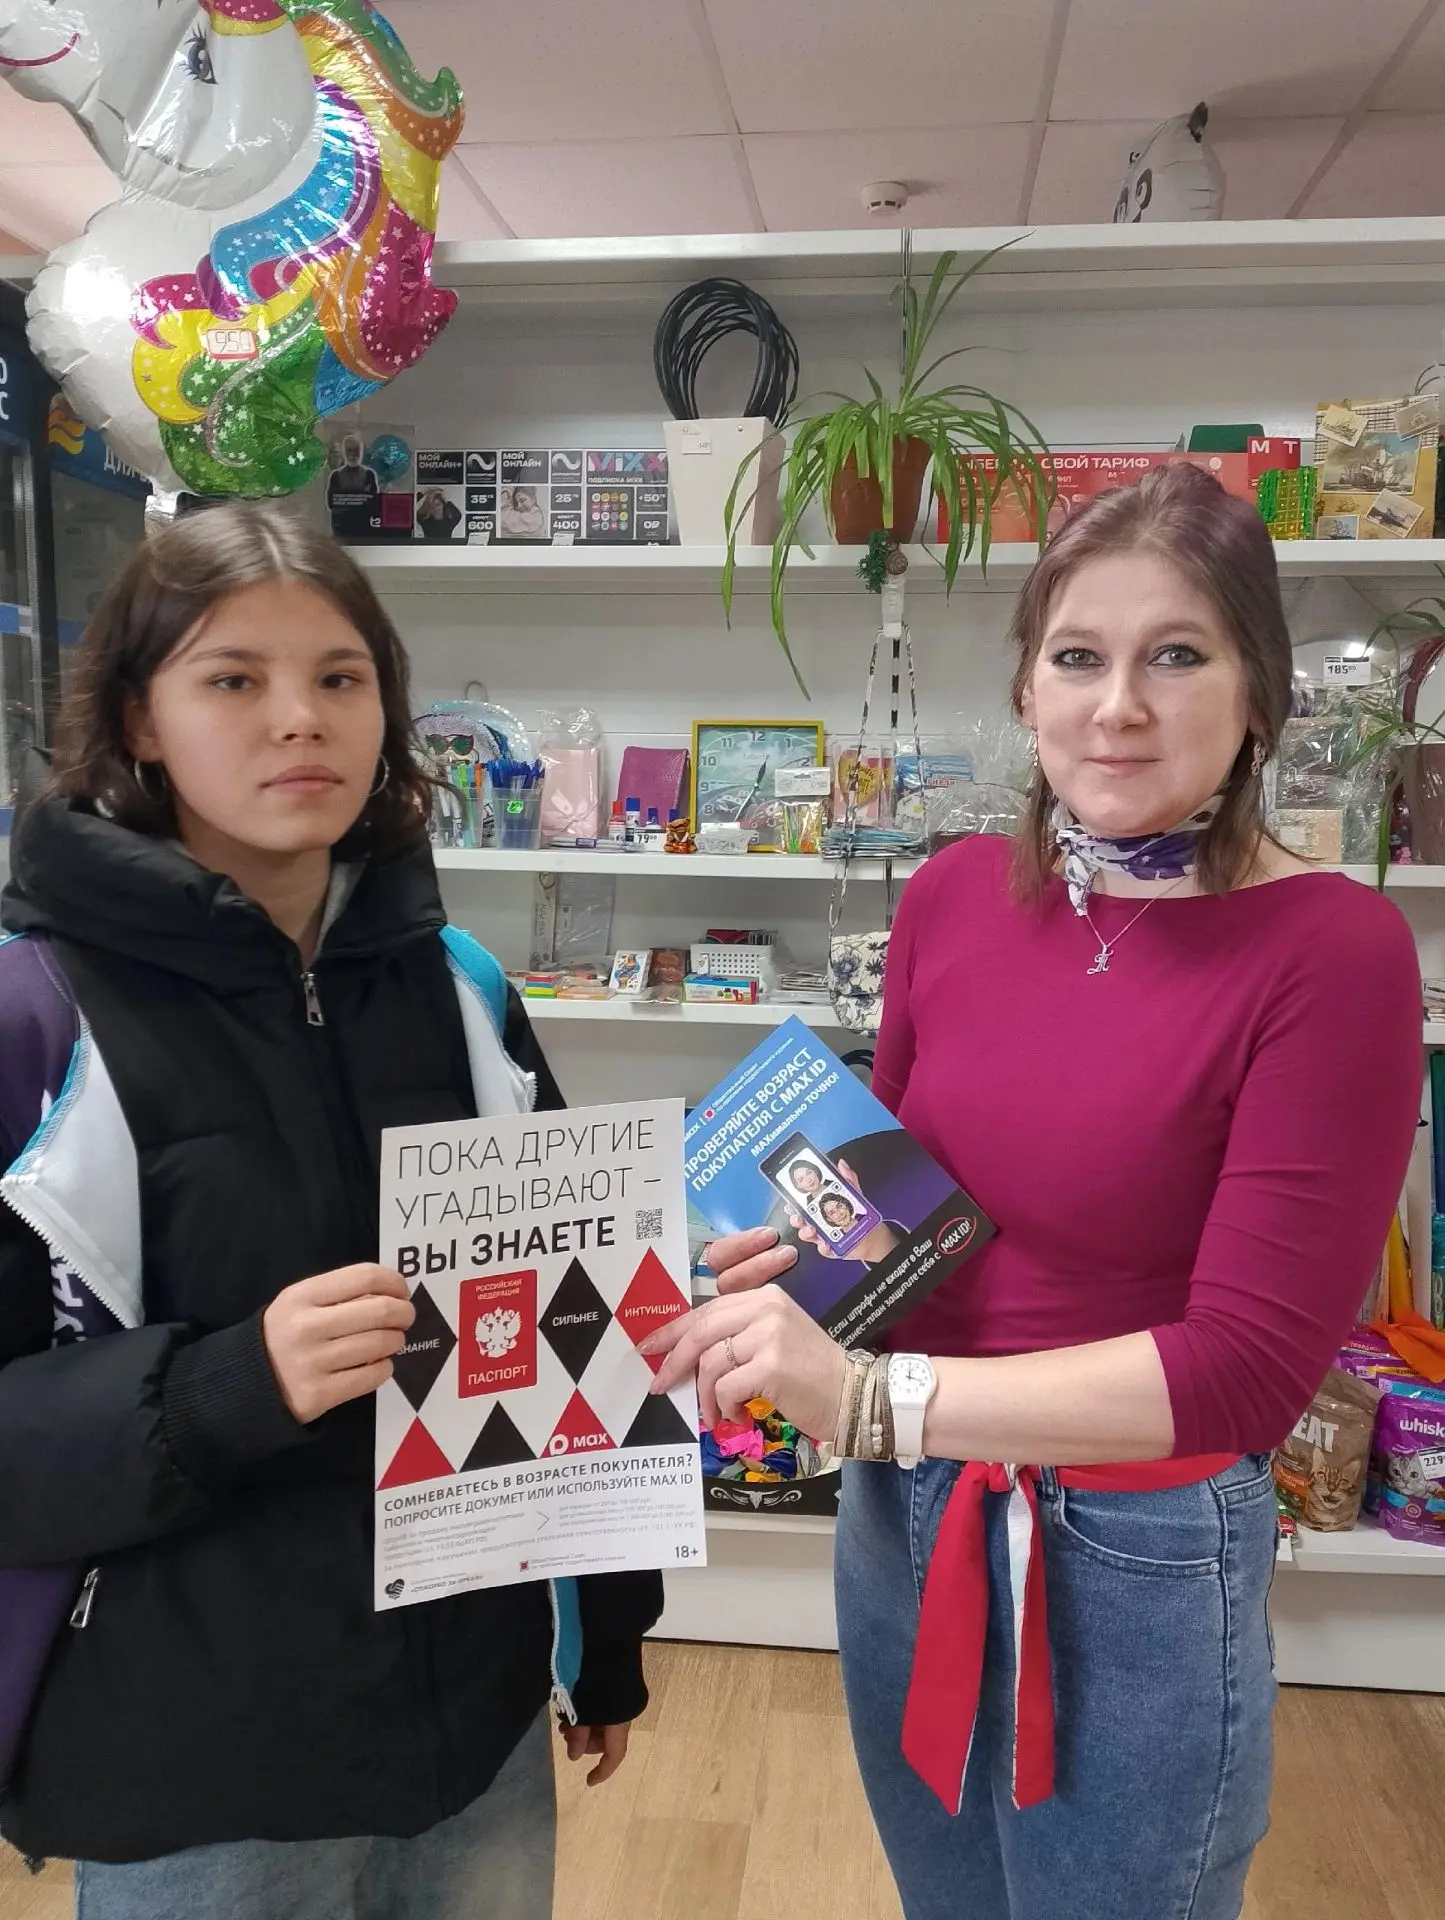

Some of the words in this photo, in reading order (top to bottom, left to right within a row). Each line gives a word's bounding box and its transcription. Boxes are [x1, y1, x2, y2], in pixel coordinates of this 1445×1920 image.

[418, 452, 441, 462] МОЙ
[502, 452, 525, 461] МОЙ
[502, 458, 542, 468] ОНЛАЙН
[1041, 454, 1089, 469] СВОЙ
[1092, 456, 1150, 469] ТАРИФ
[468, 520, 494, 531] 600
[552, 520, 580, 531] 400
[721, 738, 733, 749] 11
[785, 738, 792, 748] 1
[751, 731, 766, 742] 12
[701, 756, 717, 767] 10
[699, 782, 709, 792] 9
[704, 804, 713, 815] 8
[804, 1071, 841, 1106] ТОЧНО!
[684, 1098, 761, 1180] ПРОВЕРЯЙТЕ
[755, 1047, 813, 1104] ВОЗРАСТ
[691, 1109, 774, 1193] ПОКУПАТЕЛЯ
[808, 1058, 828, 1078] ID
[398, 1135, 504, 1179] ПОКА
[515, 1118, 655, 1170] ДРУГИЕ
[395, 1166, 634, 1229] УГАДЫВАЮТ
[397, 1238, 457, 1279] ВЫ
[470, 1215, 616, 1266] ЗНАЕТЕ
[475, 1278, 523, 1292] РОССИЙСКАЯ
[828, 1319, 848, 1339] Если
[846, 1290, 879, 1322] штрафы
[876, 1281, 888, 1295] не
[886, 1259, 911, 1285] входят
[912, 1238, 934, 1258] Ваш
[883, 1273, 919, 1307] защитите
[917, 1257, 936, 1276] себя
[477, 1288, 521, 1301] ФЕДЕРАЦИЯ
[624, 1303, 682, 1318] ИНТУИЦИИ
[552, 1311, 600, 1327] СИЛЬНЕЕ
[467, 1364, 529, 1386] ПАСПОРТ
[1399, 1417, 1445, 1438] whisk
[384, 1480, 499, 1512] СОМНЕВАЕТЕСЬ
[503, 1475, 512, 1488] В
[515, 1464, 587, 1487] ВОЗРАСТЕ
[590, 1453, 693, 1475] ПОКУПАТЕЛЯ?
[383, 1502, 462, 1530] ПОПРОСИТЕ
[464, 1491, 525, 1515] ДОКУМЕТ
[527, 1485, 554, 1501] ИЛИ
[556, 1474, 647, 1497] ИСПОЛЬЗУЙТЕ
[680, 1473, 693, 1485] ID
[674, 1545, 699, 1559] 18+
